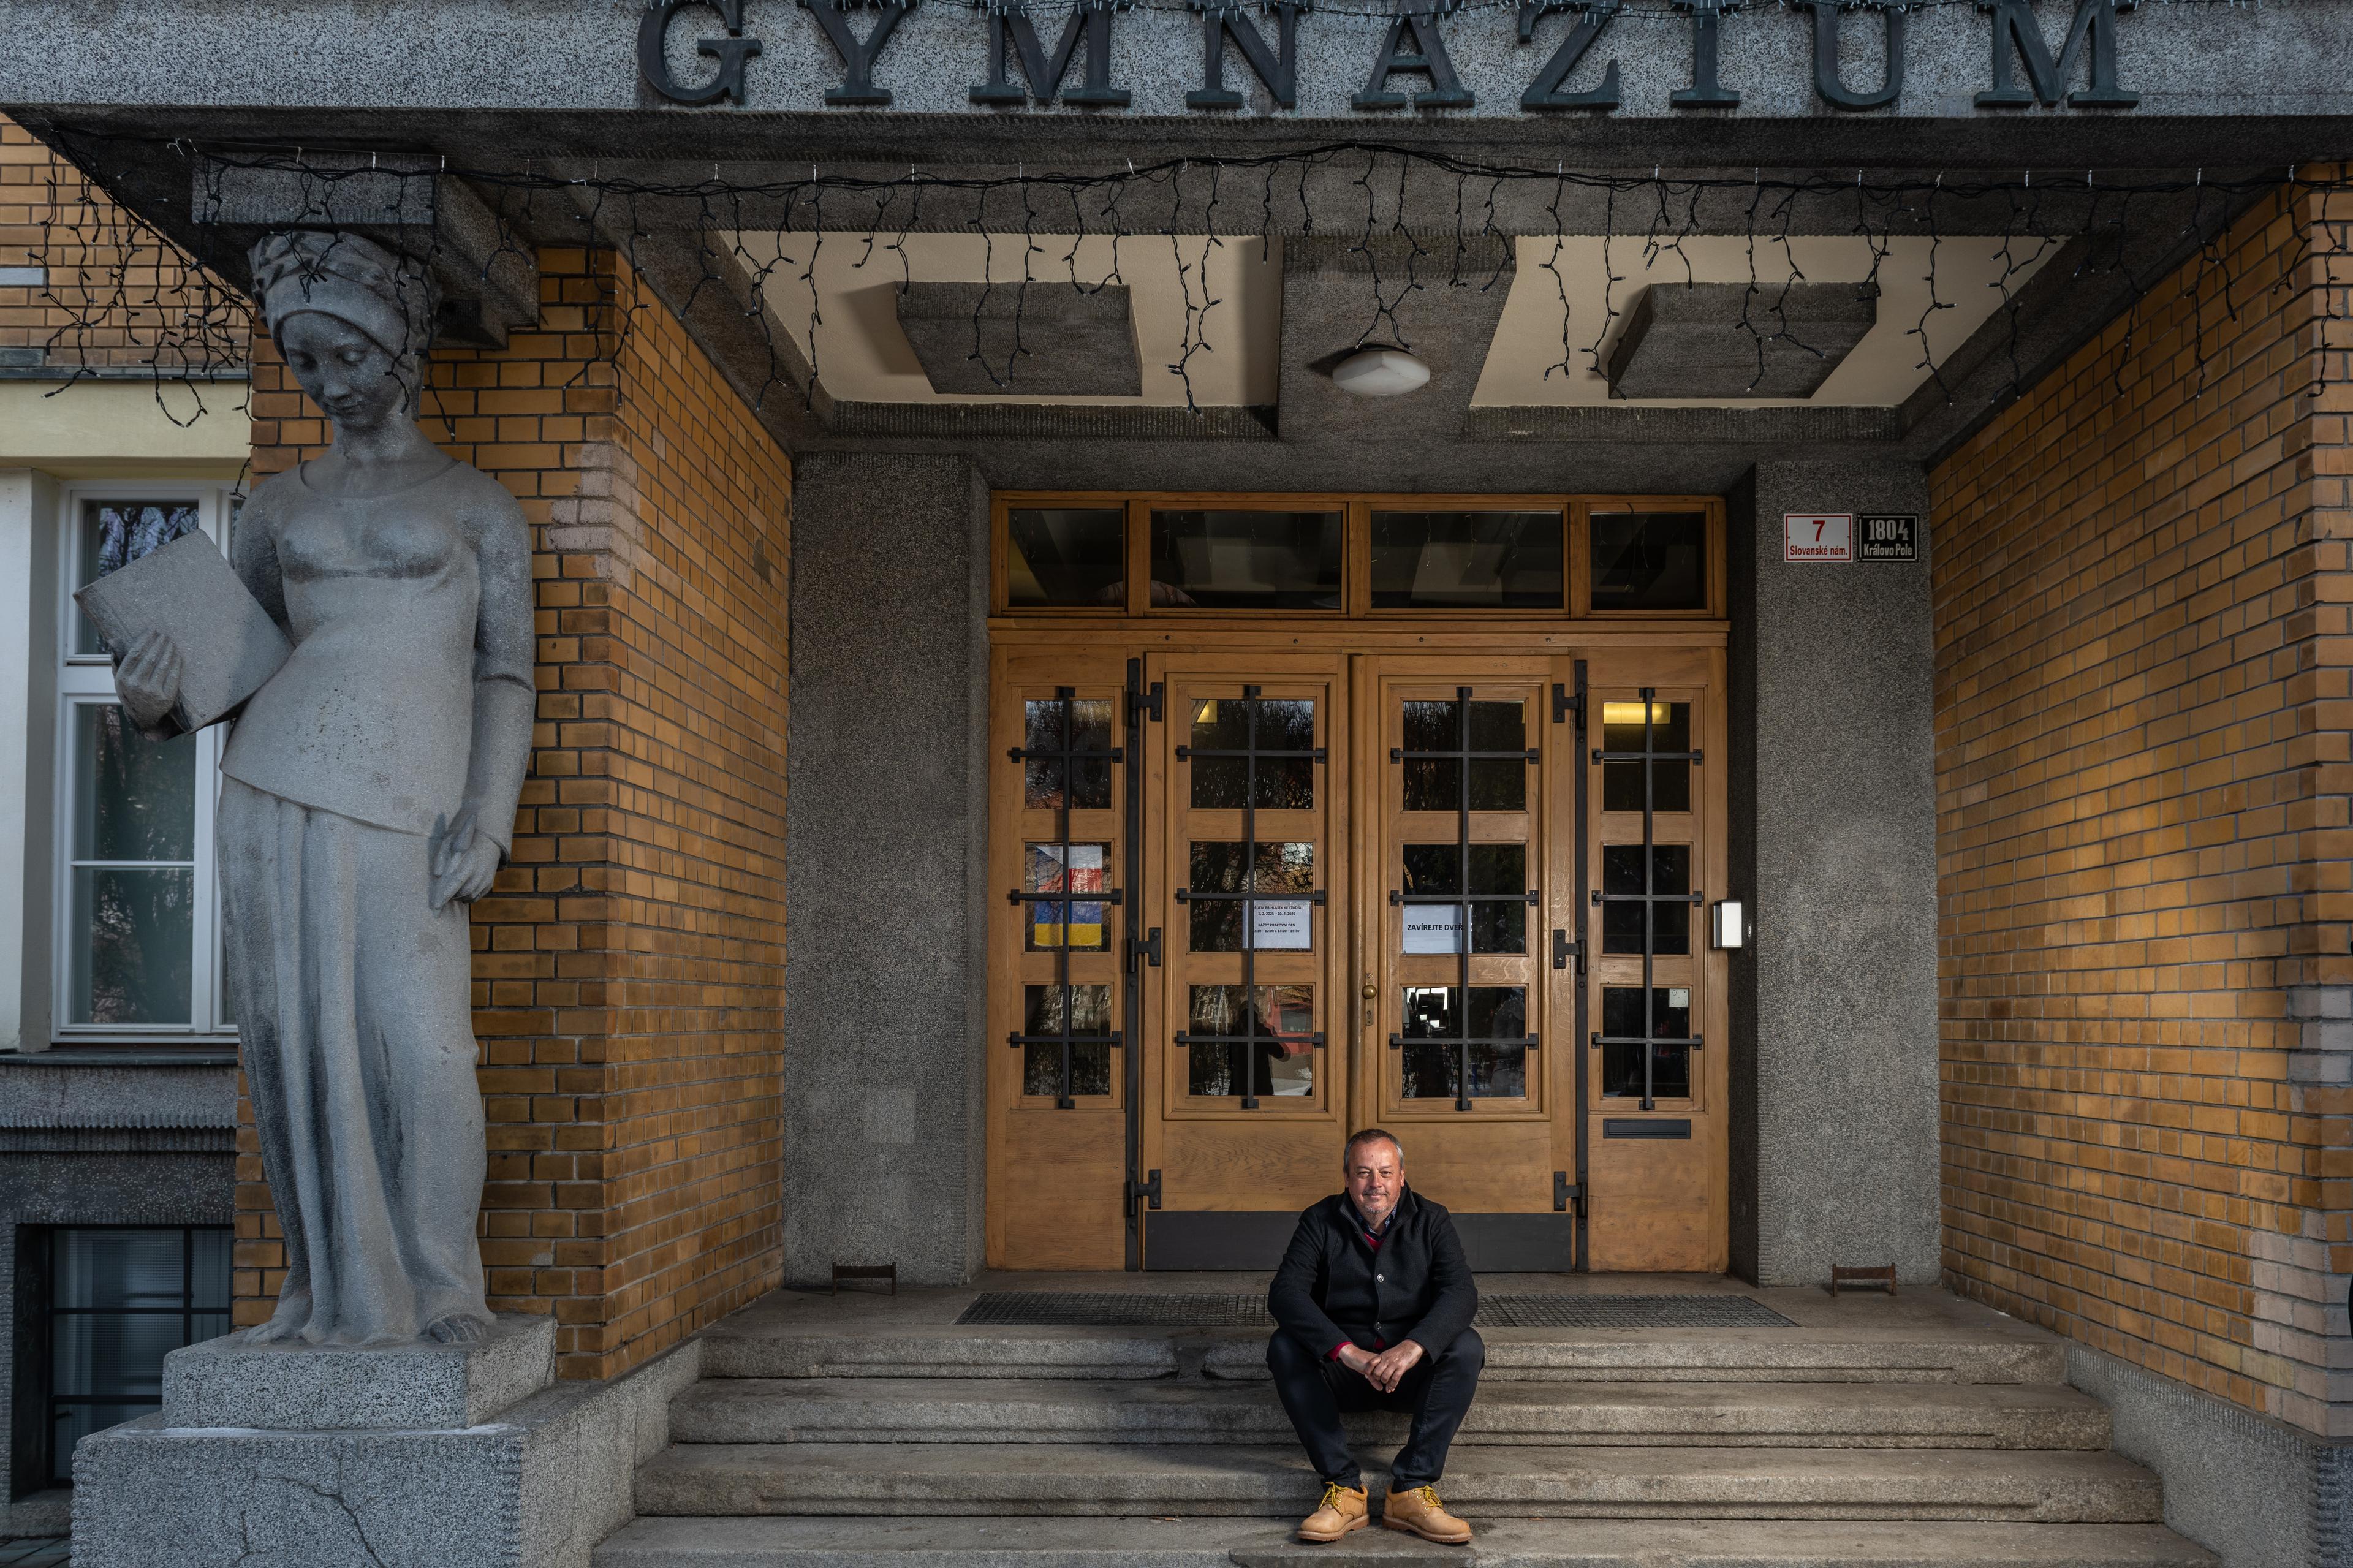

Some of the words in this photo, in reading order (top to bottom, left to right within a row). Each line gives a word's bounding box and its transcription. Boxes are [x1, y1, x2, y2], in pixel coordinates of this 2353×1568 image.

[1813, 520, 1825, 542] 7
[1868, 520, 1909, 540] 1804
[1790, 545, 1828, 556] Slovanské
[1830, 545, 1848, 556] nám.
[1863, 543, 1894, 556] Královo
[1895, 543, 1912, 556] Pole
[1444, 922, 1463, 931] DVEŘ
